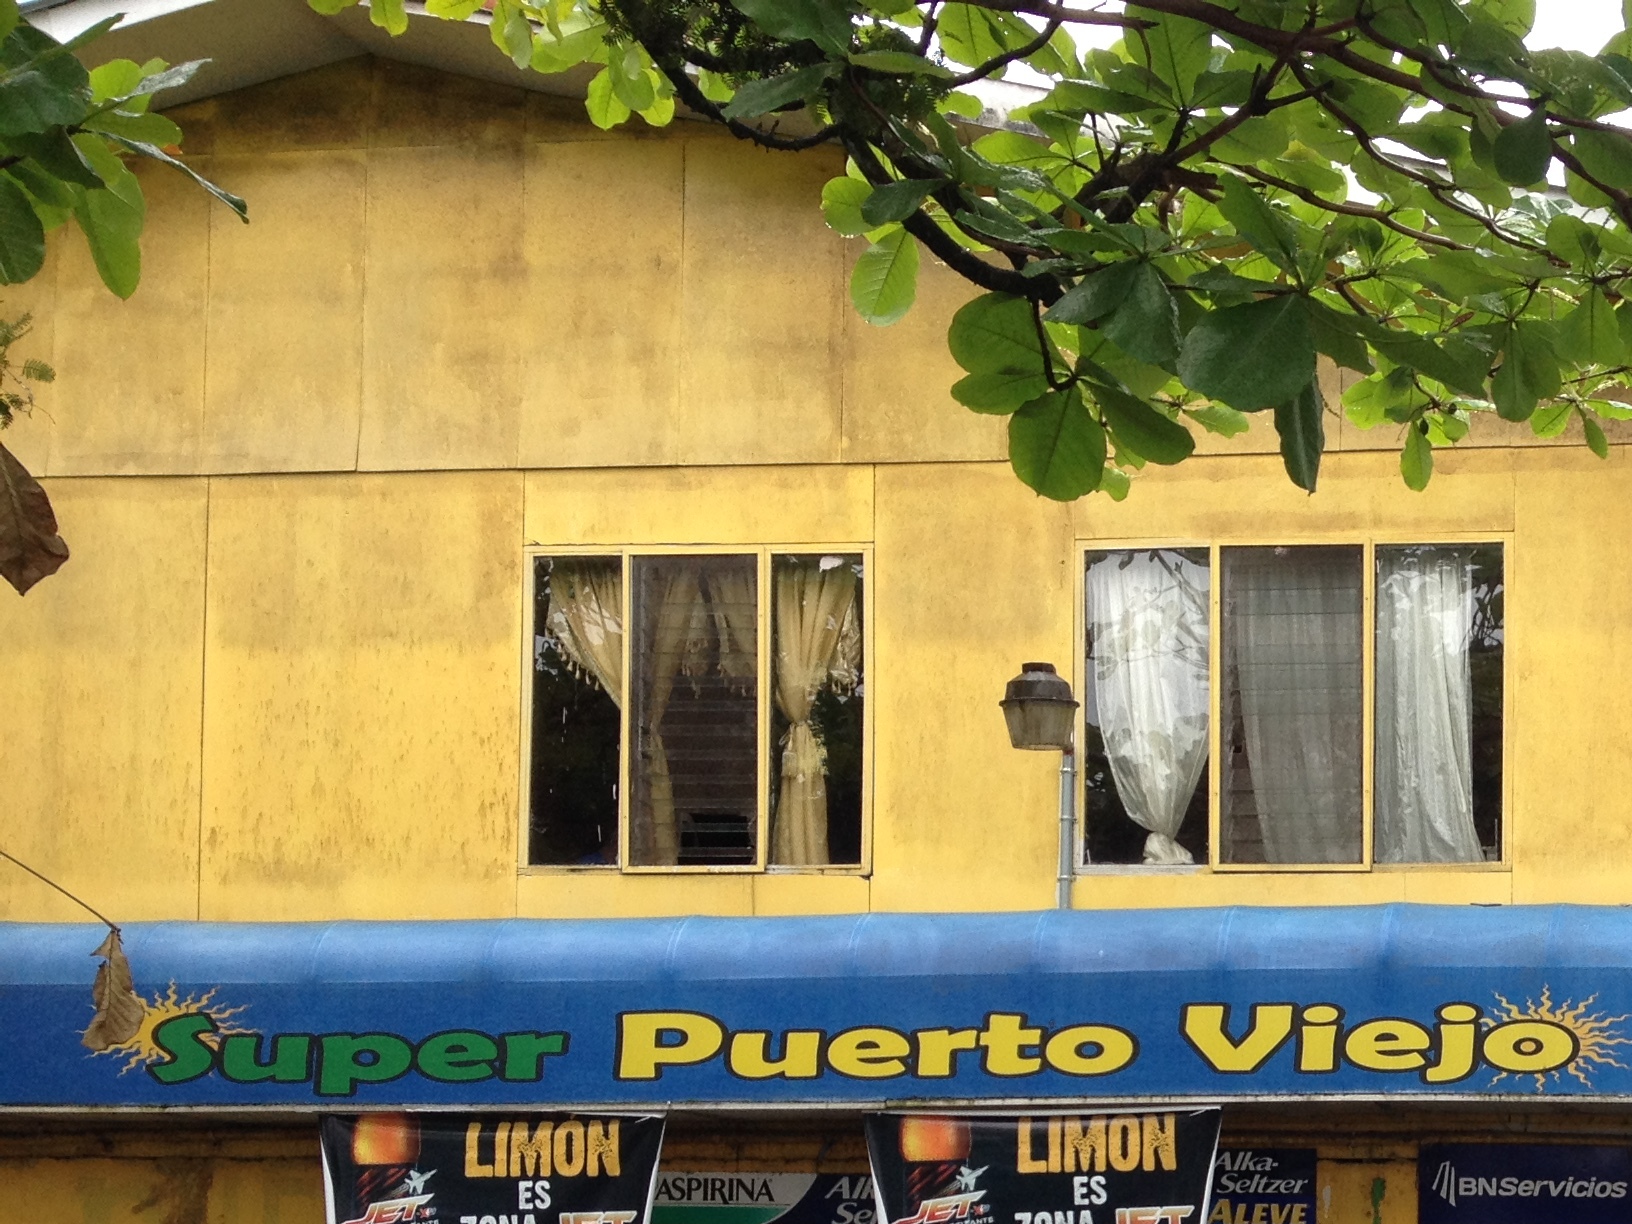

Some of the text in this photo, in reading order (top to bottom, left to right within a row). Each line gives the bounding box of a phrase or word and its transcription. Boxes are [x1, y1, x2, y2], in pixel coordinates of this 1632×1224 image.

[147, 1001, 1582, 1097] Super Puerto Viejo
[1214, 1151, 1279, 1172] Alka-
[518, 1180, 551, 1210] ES
[655, 1178, 775, 1203] ASPIRINA
[1072, 1176, 1107, 1206] ES
[1216, 1174, 1308, 1195] Seltzer
